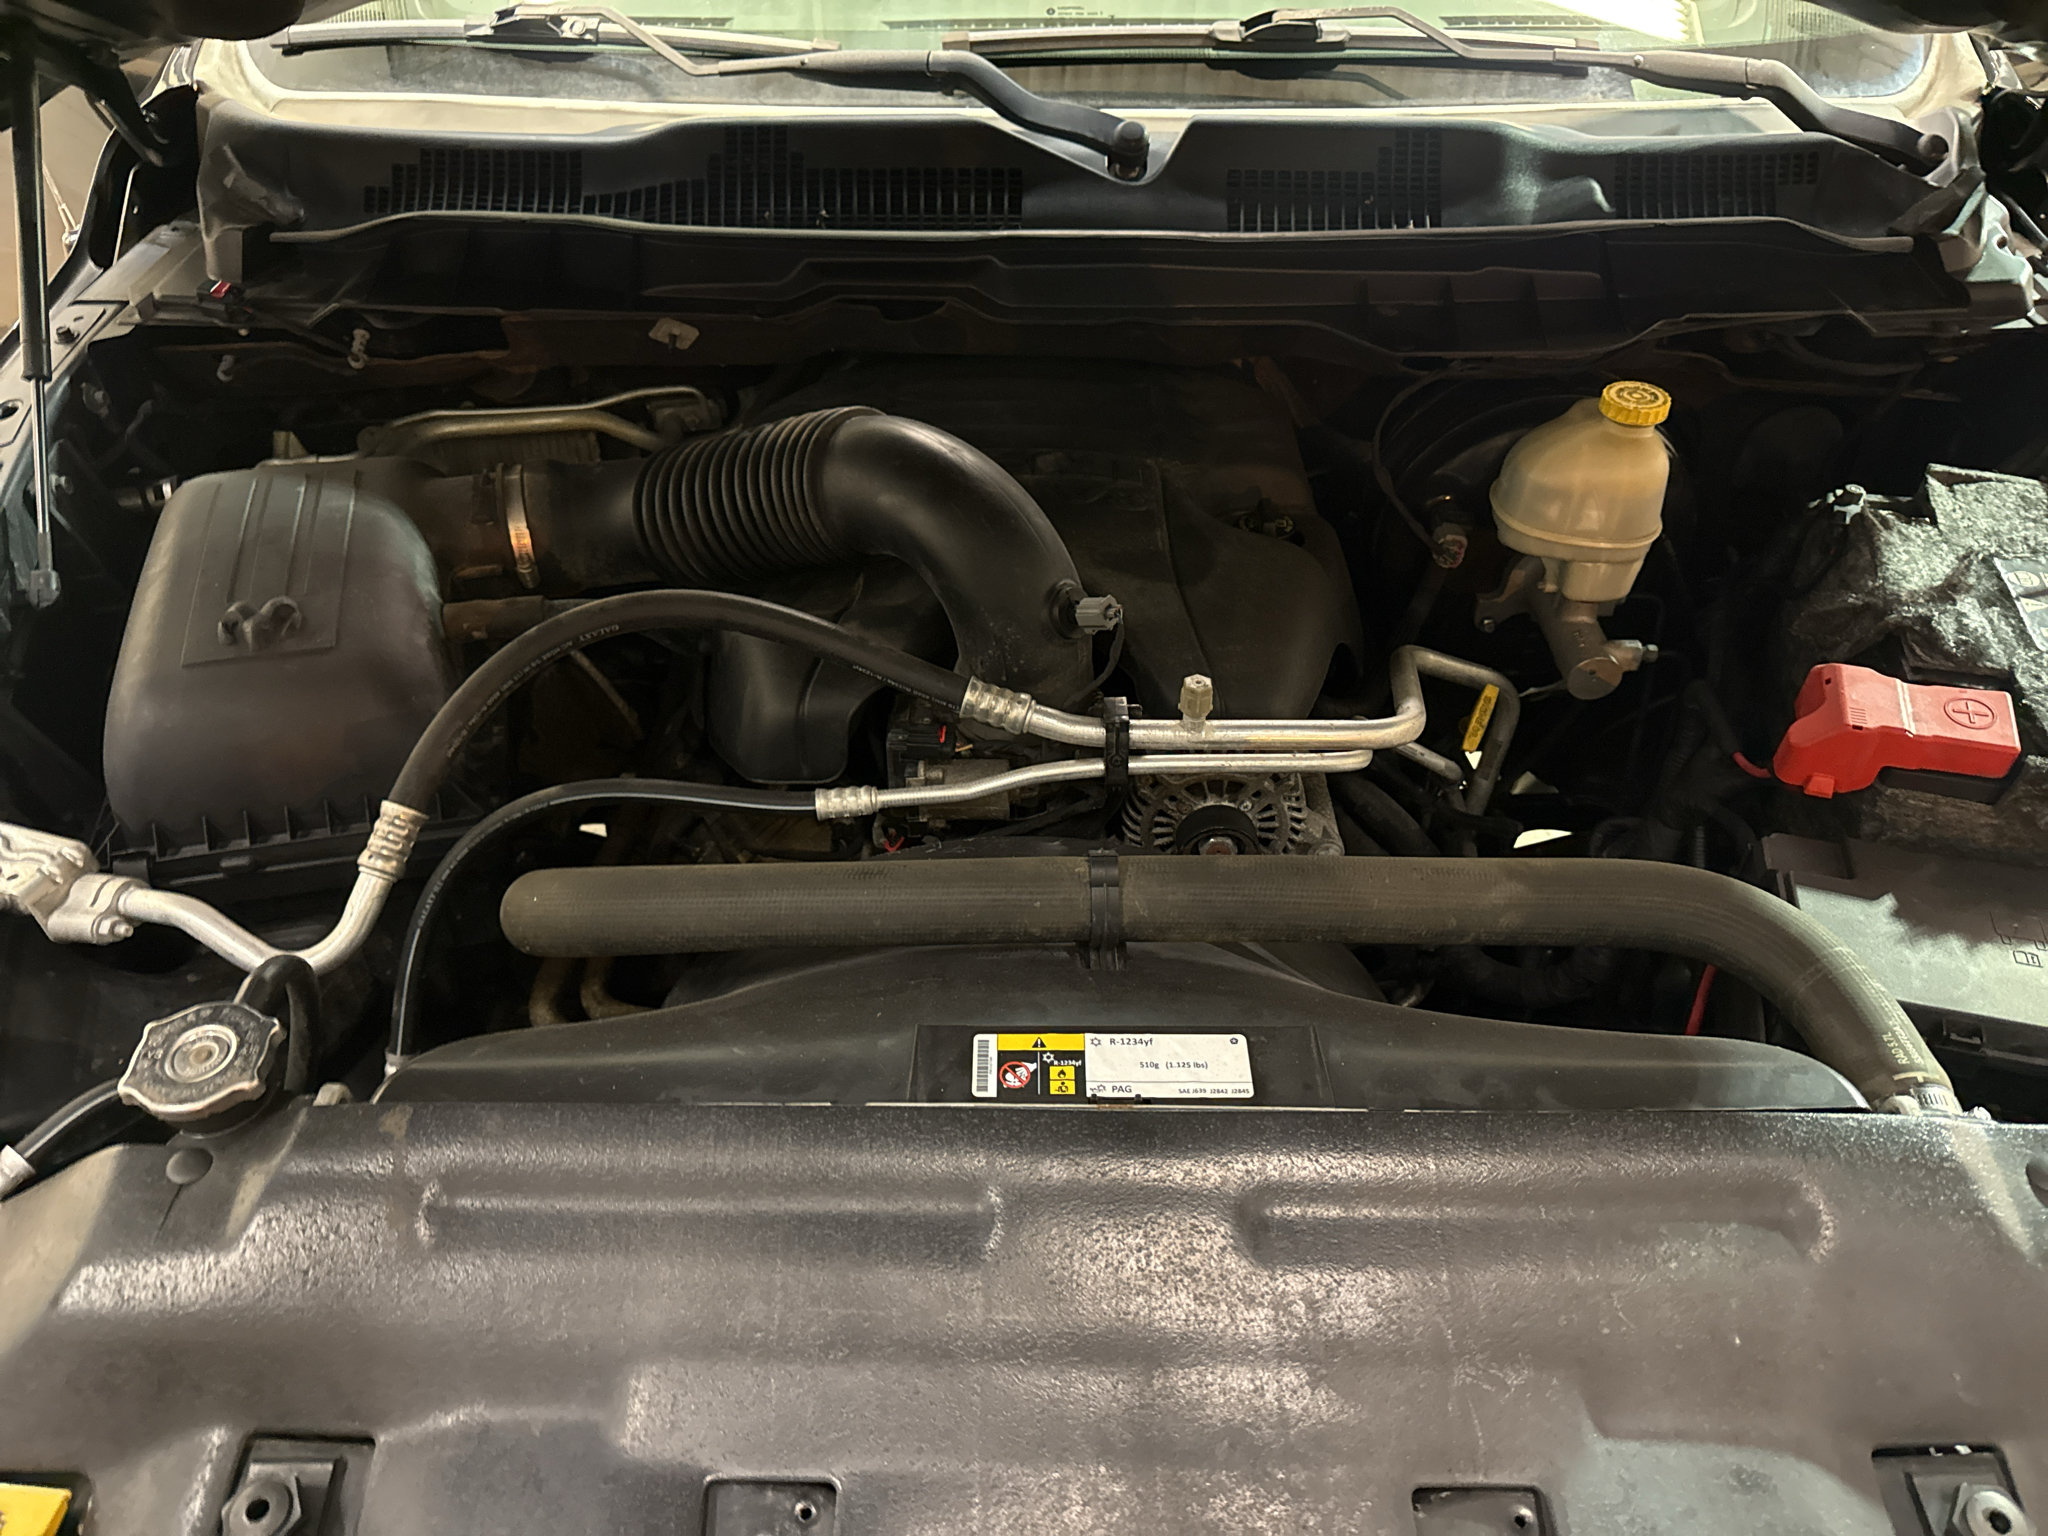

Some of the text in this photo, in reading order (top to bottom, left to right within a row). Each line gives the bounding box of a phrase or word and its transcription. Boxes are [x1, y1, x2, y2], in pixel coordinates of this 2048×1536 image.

[1109, 1037, 1153, 1047] R-1234yf
[1892, 1048, 1910, 1065] RAD
[1053, 1059, 1082, 1067] R-1234yf
[1139, 1061, 1208, 1069] 510g (1.125 lbs)
[1111, 1085, 1132, 1093] PAG
